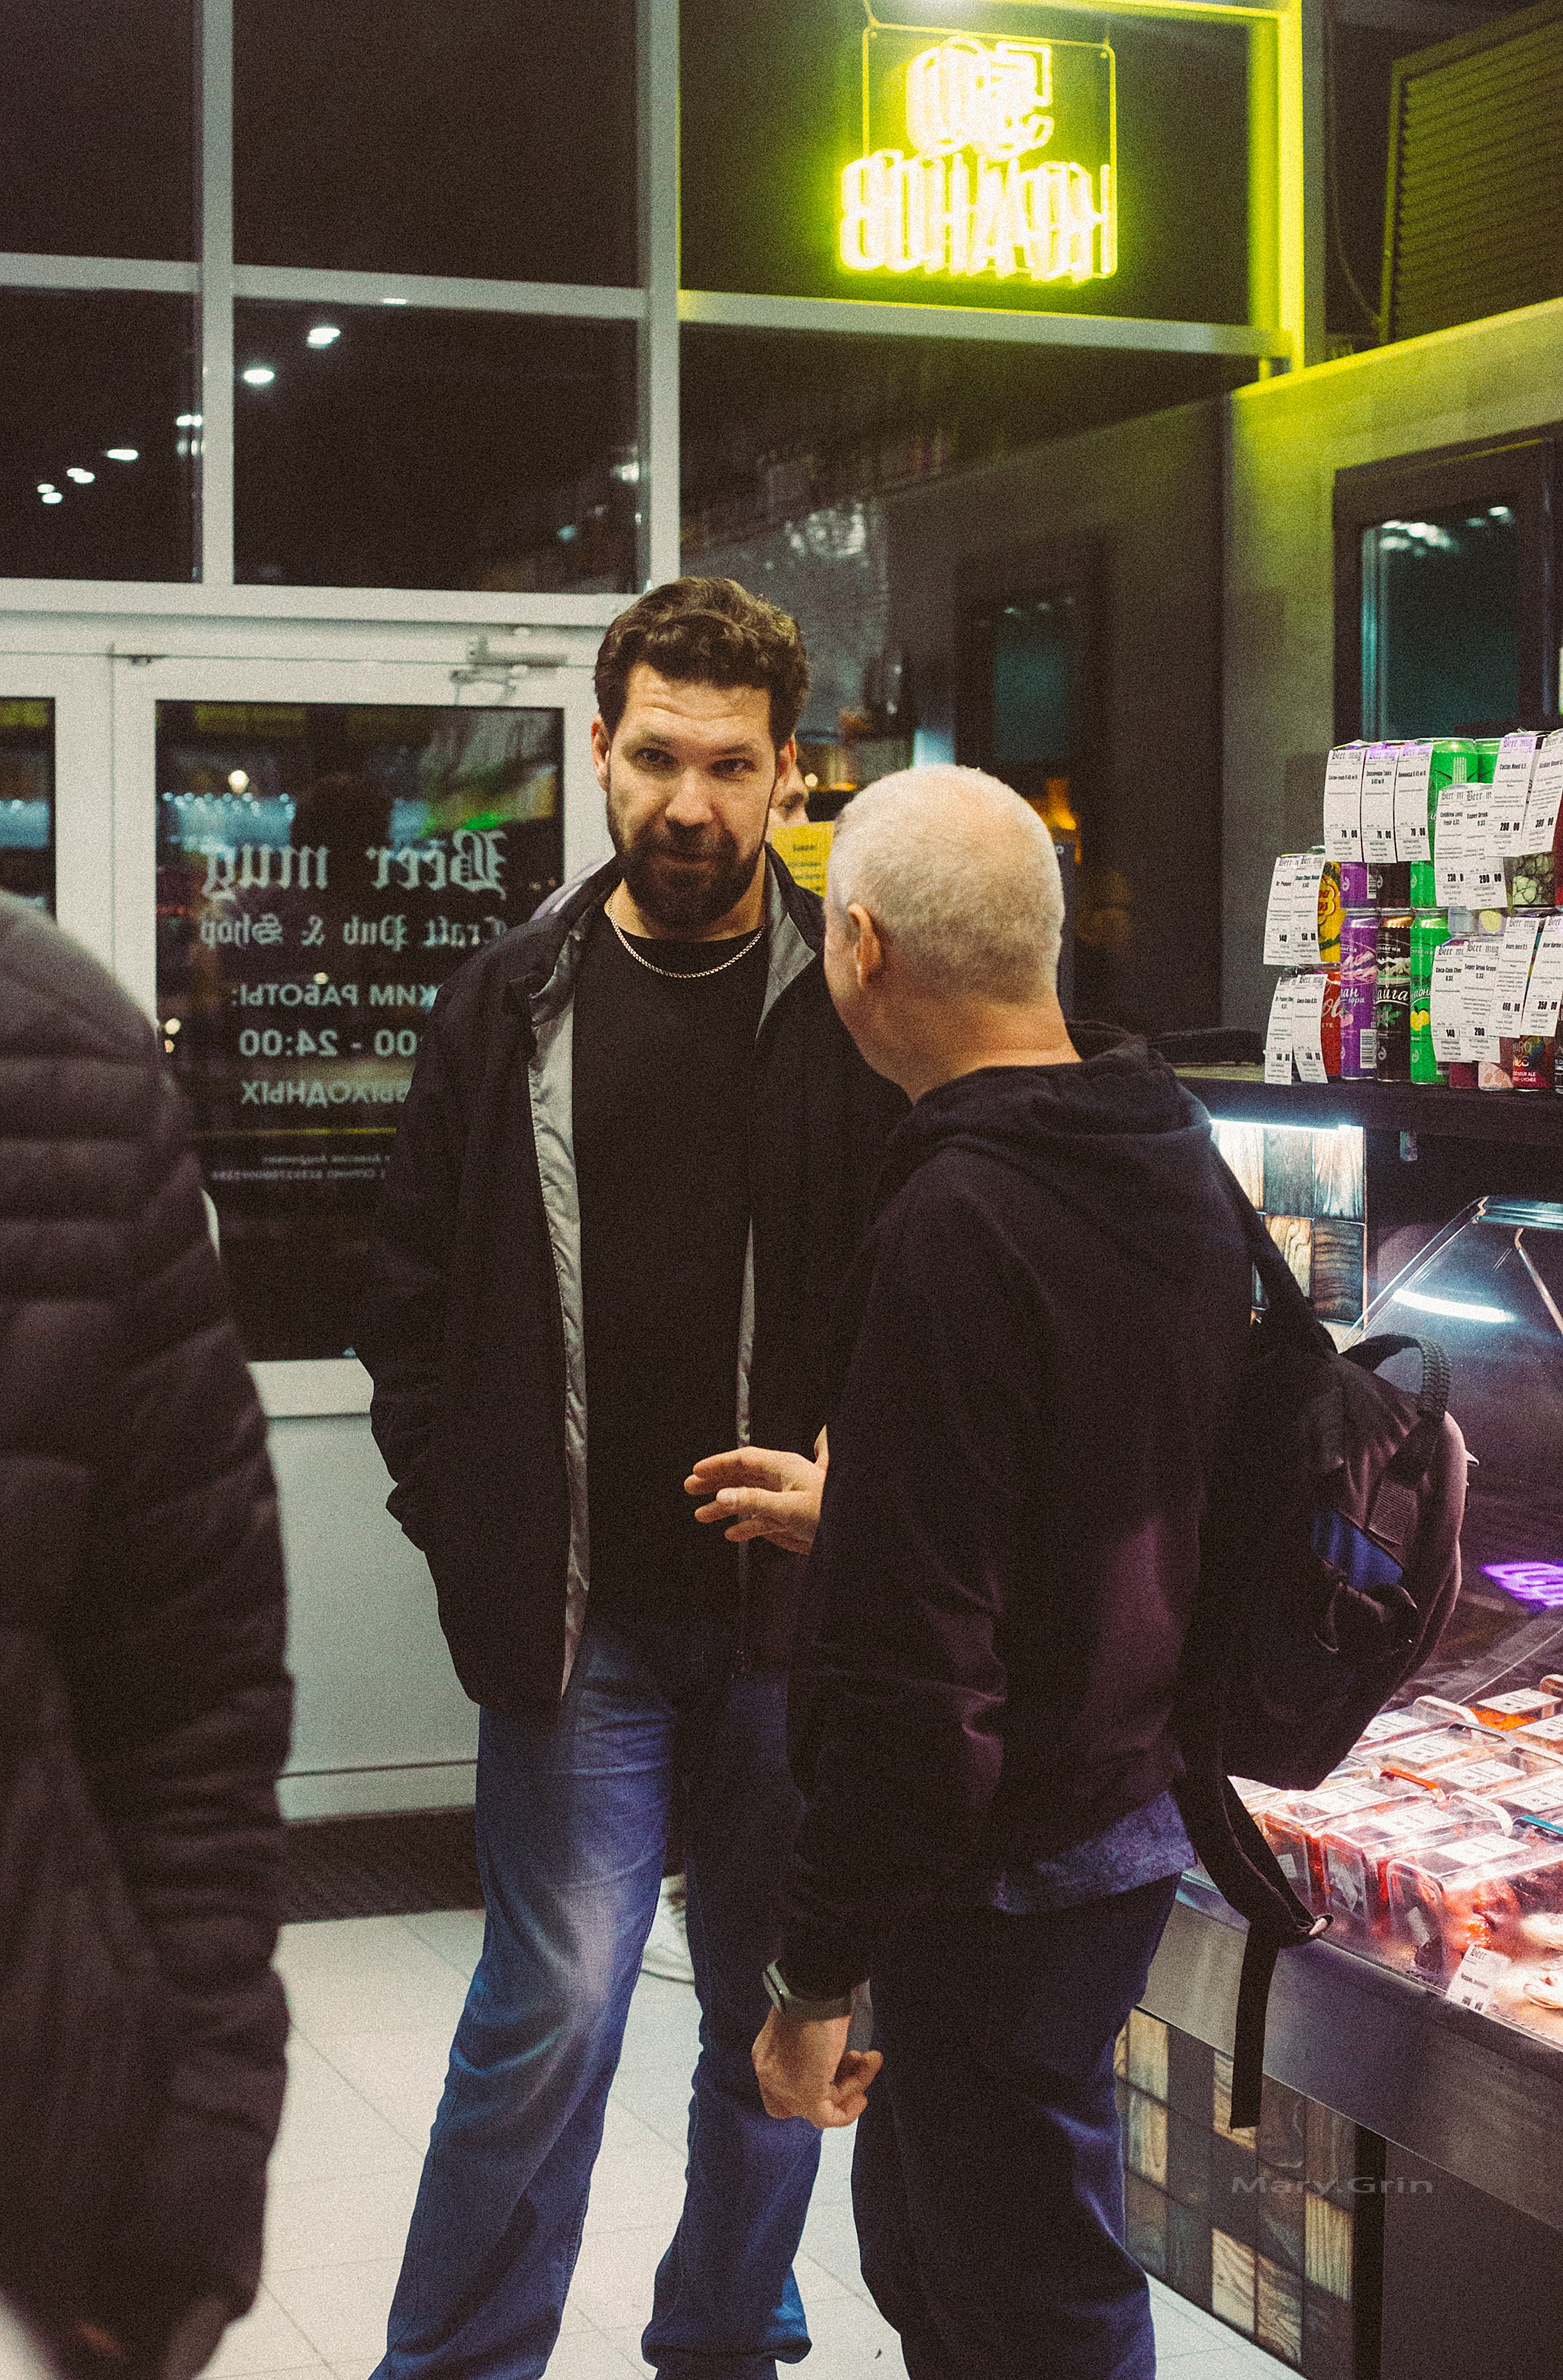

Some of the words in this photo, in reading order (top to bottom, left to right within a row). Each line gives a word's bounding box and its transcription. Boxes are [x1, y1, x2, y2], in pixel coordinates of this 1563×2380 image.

[1351, 829, 1358, 838] 00
[1420, 827, 1426, 836] 00
[1377, 984, 1409, 1002] айга
[1445, 1029, 1455, 1038] 140
[1474, 1027, 1485, 1036] 200
